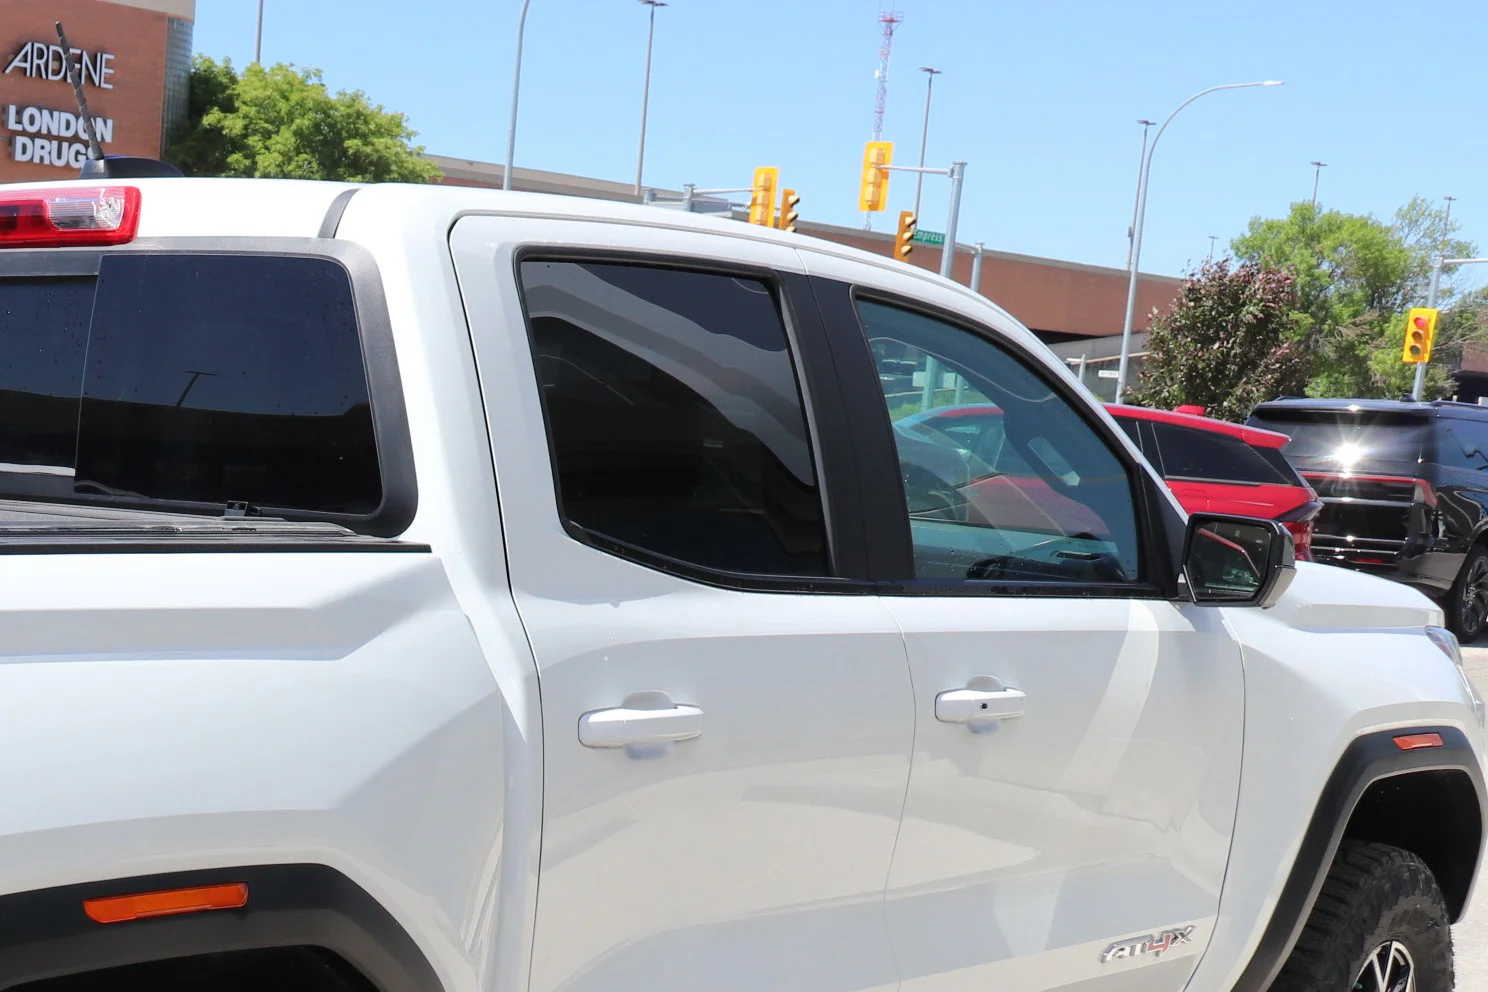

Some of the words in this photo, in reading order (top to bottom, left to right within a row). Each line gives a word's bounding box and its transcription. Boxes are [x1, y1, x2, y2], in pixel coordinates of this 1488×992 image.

[4, 41, 114, 89] ARDENE
[8, 104, 113, 143] LONDON
[1100, 925, 1196, 963] AT4X
